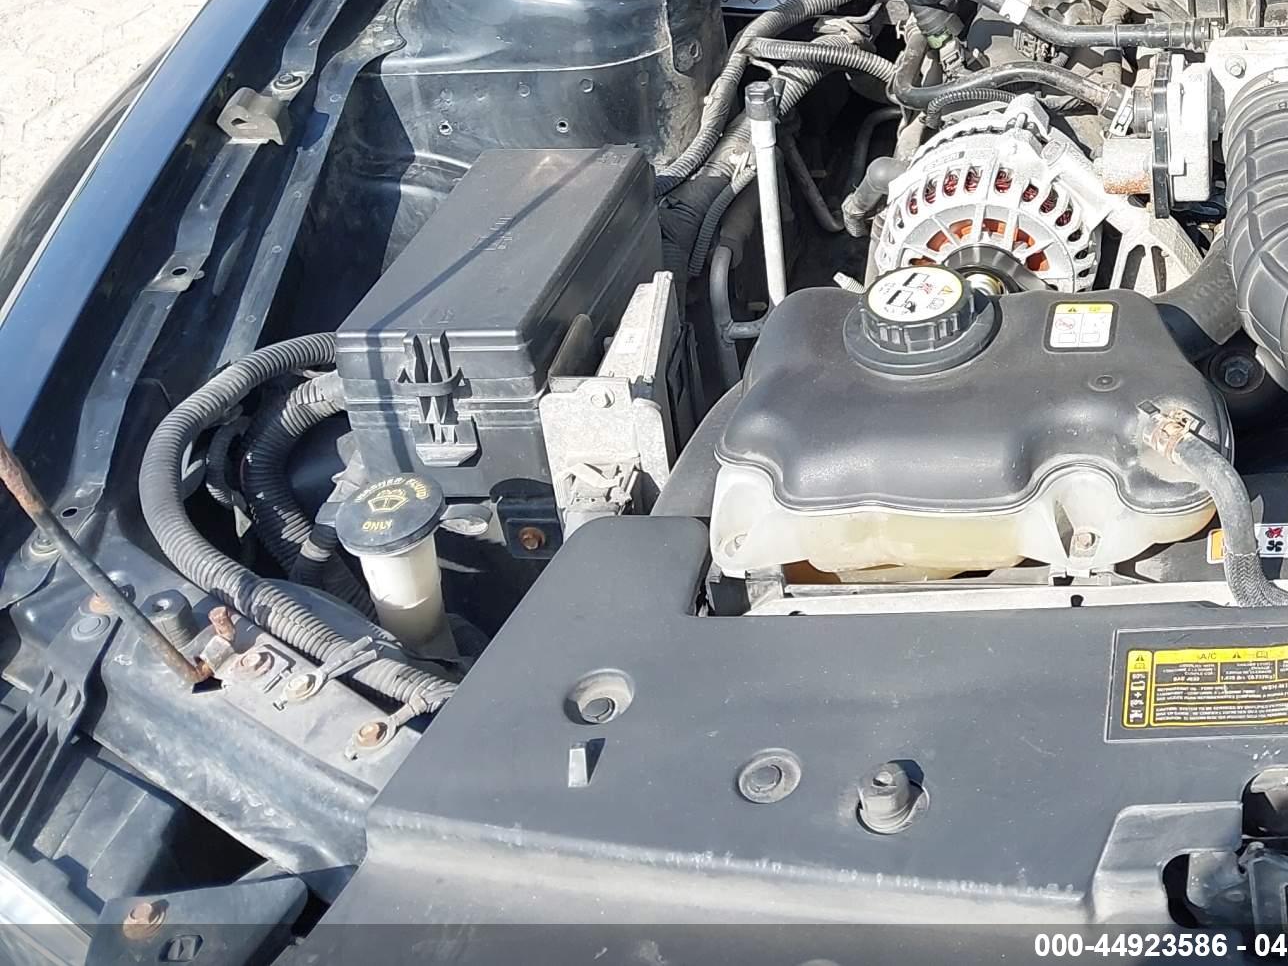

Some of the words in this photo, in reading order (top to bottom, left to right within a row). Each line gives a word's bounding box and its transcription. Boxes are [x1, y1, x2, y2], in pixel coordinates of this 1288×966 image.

[404, 477, 431, 500] FLUID
[361, 519, 393, 532] ONLY
[1199, 652, 1217, 660] A/C
